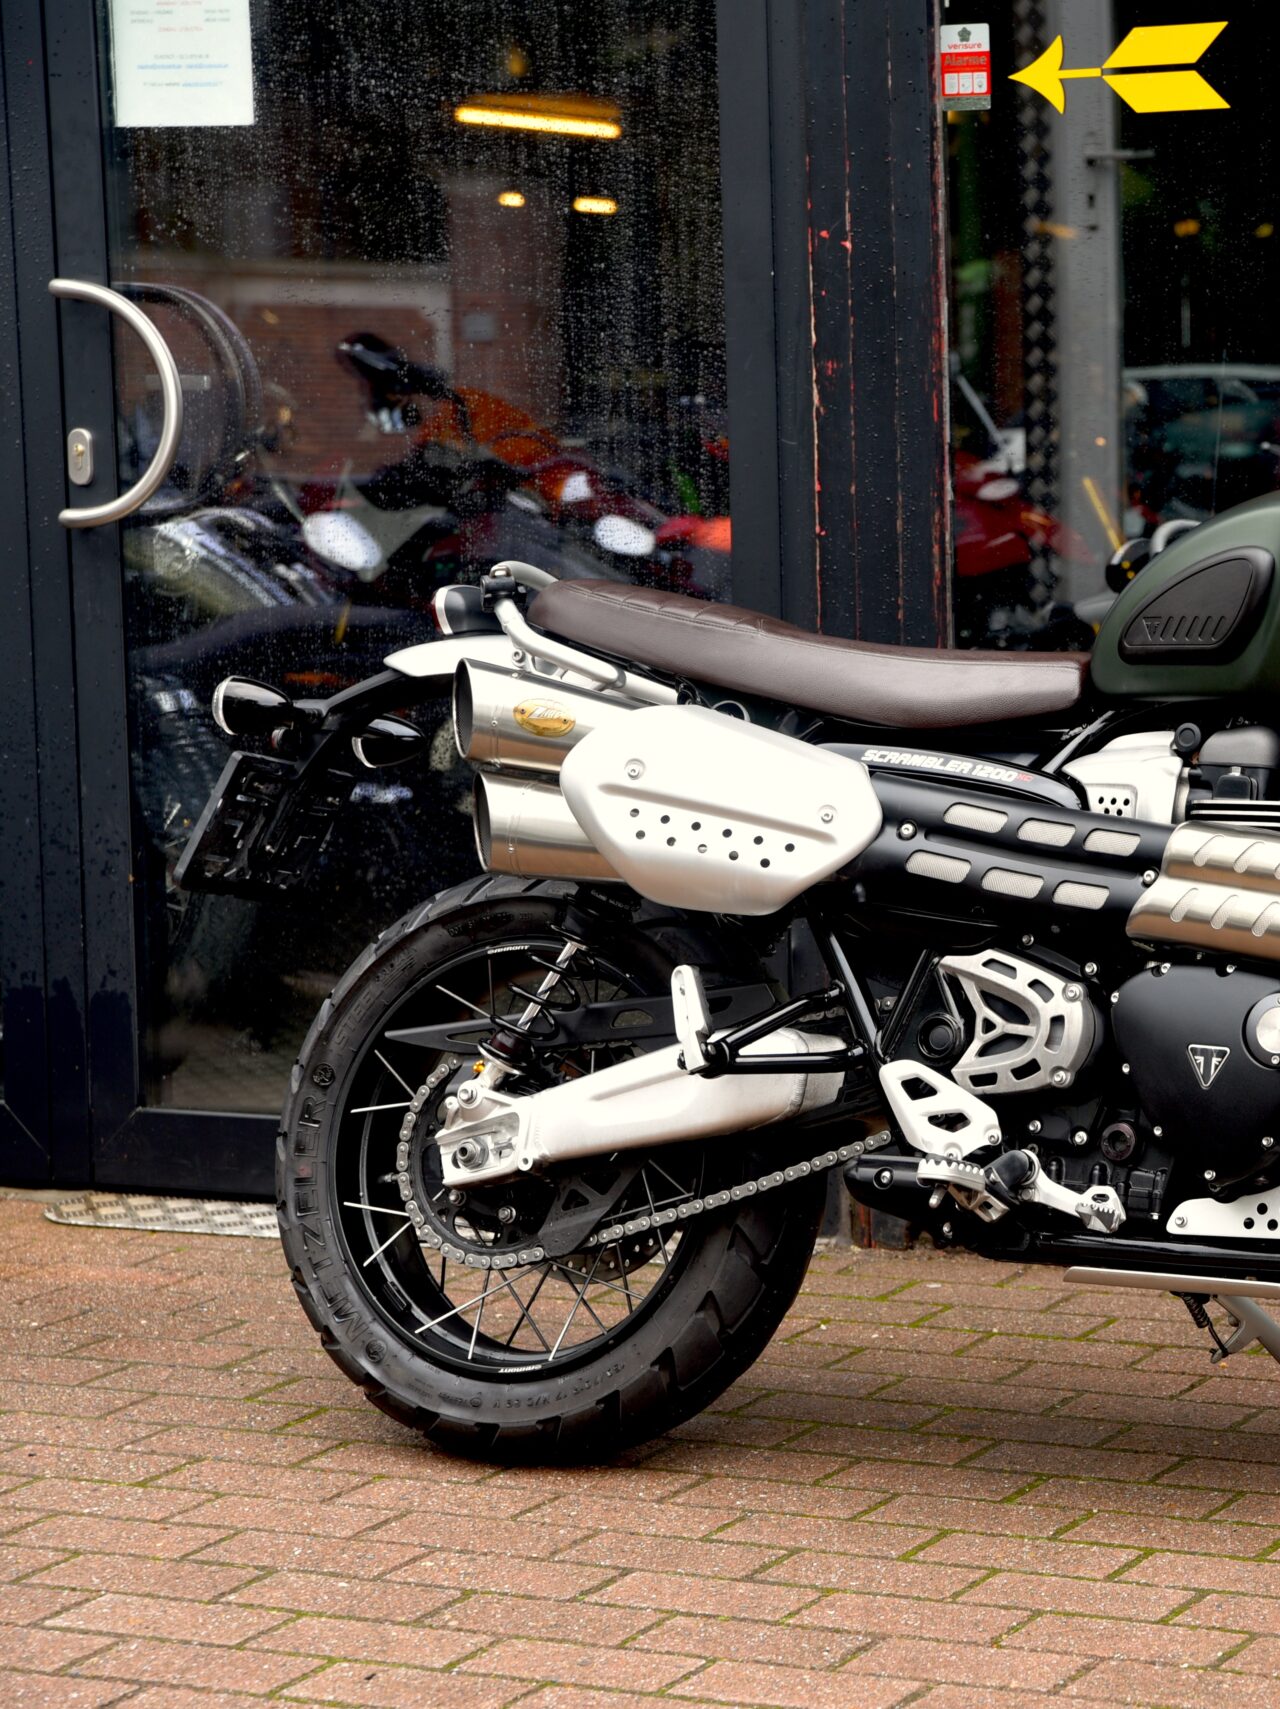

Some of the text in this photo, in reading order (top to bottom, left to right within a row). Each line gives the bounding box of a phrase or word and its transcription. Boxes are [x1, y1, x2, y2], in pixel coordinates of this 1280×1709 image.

[947, 42, 982, 50] verisure
[861, 748, 972, 774] SCRAMBLER
[972, 764, 1019, 783] 1200
[292, 1094, 370, 1342] METZELER
